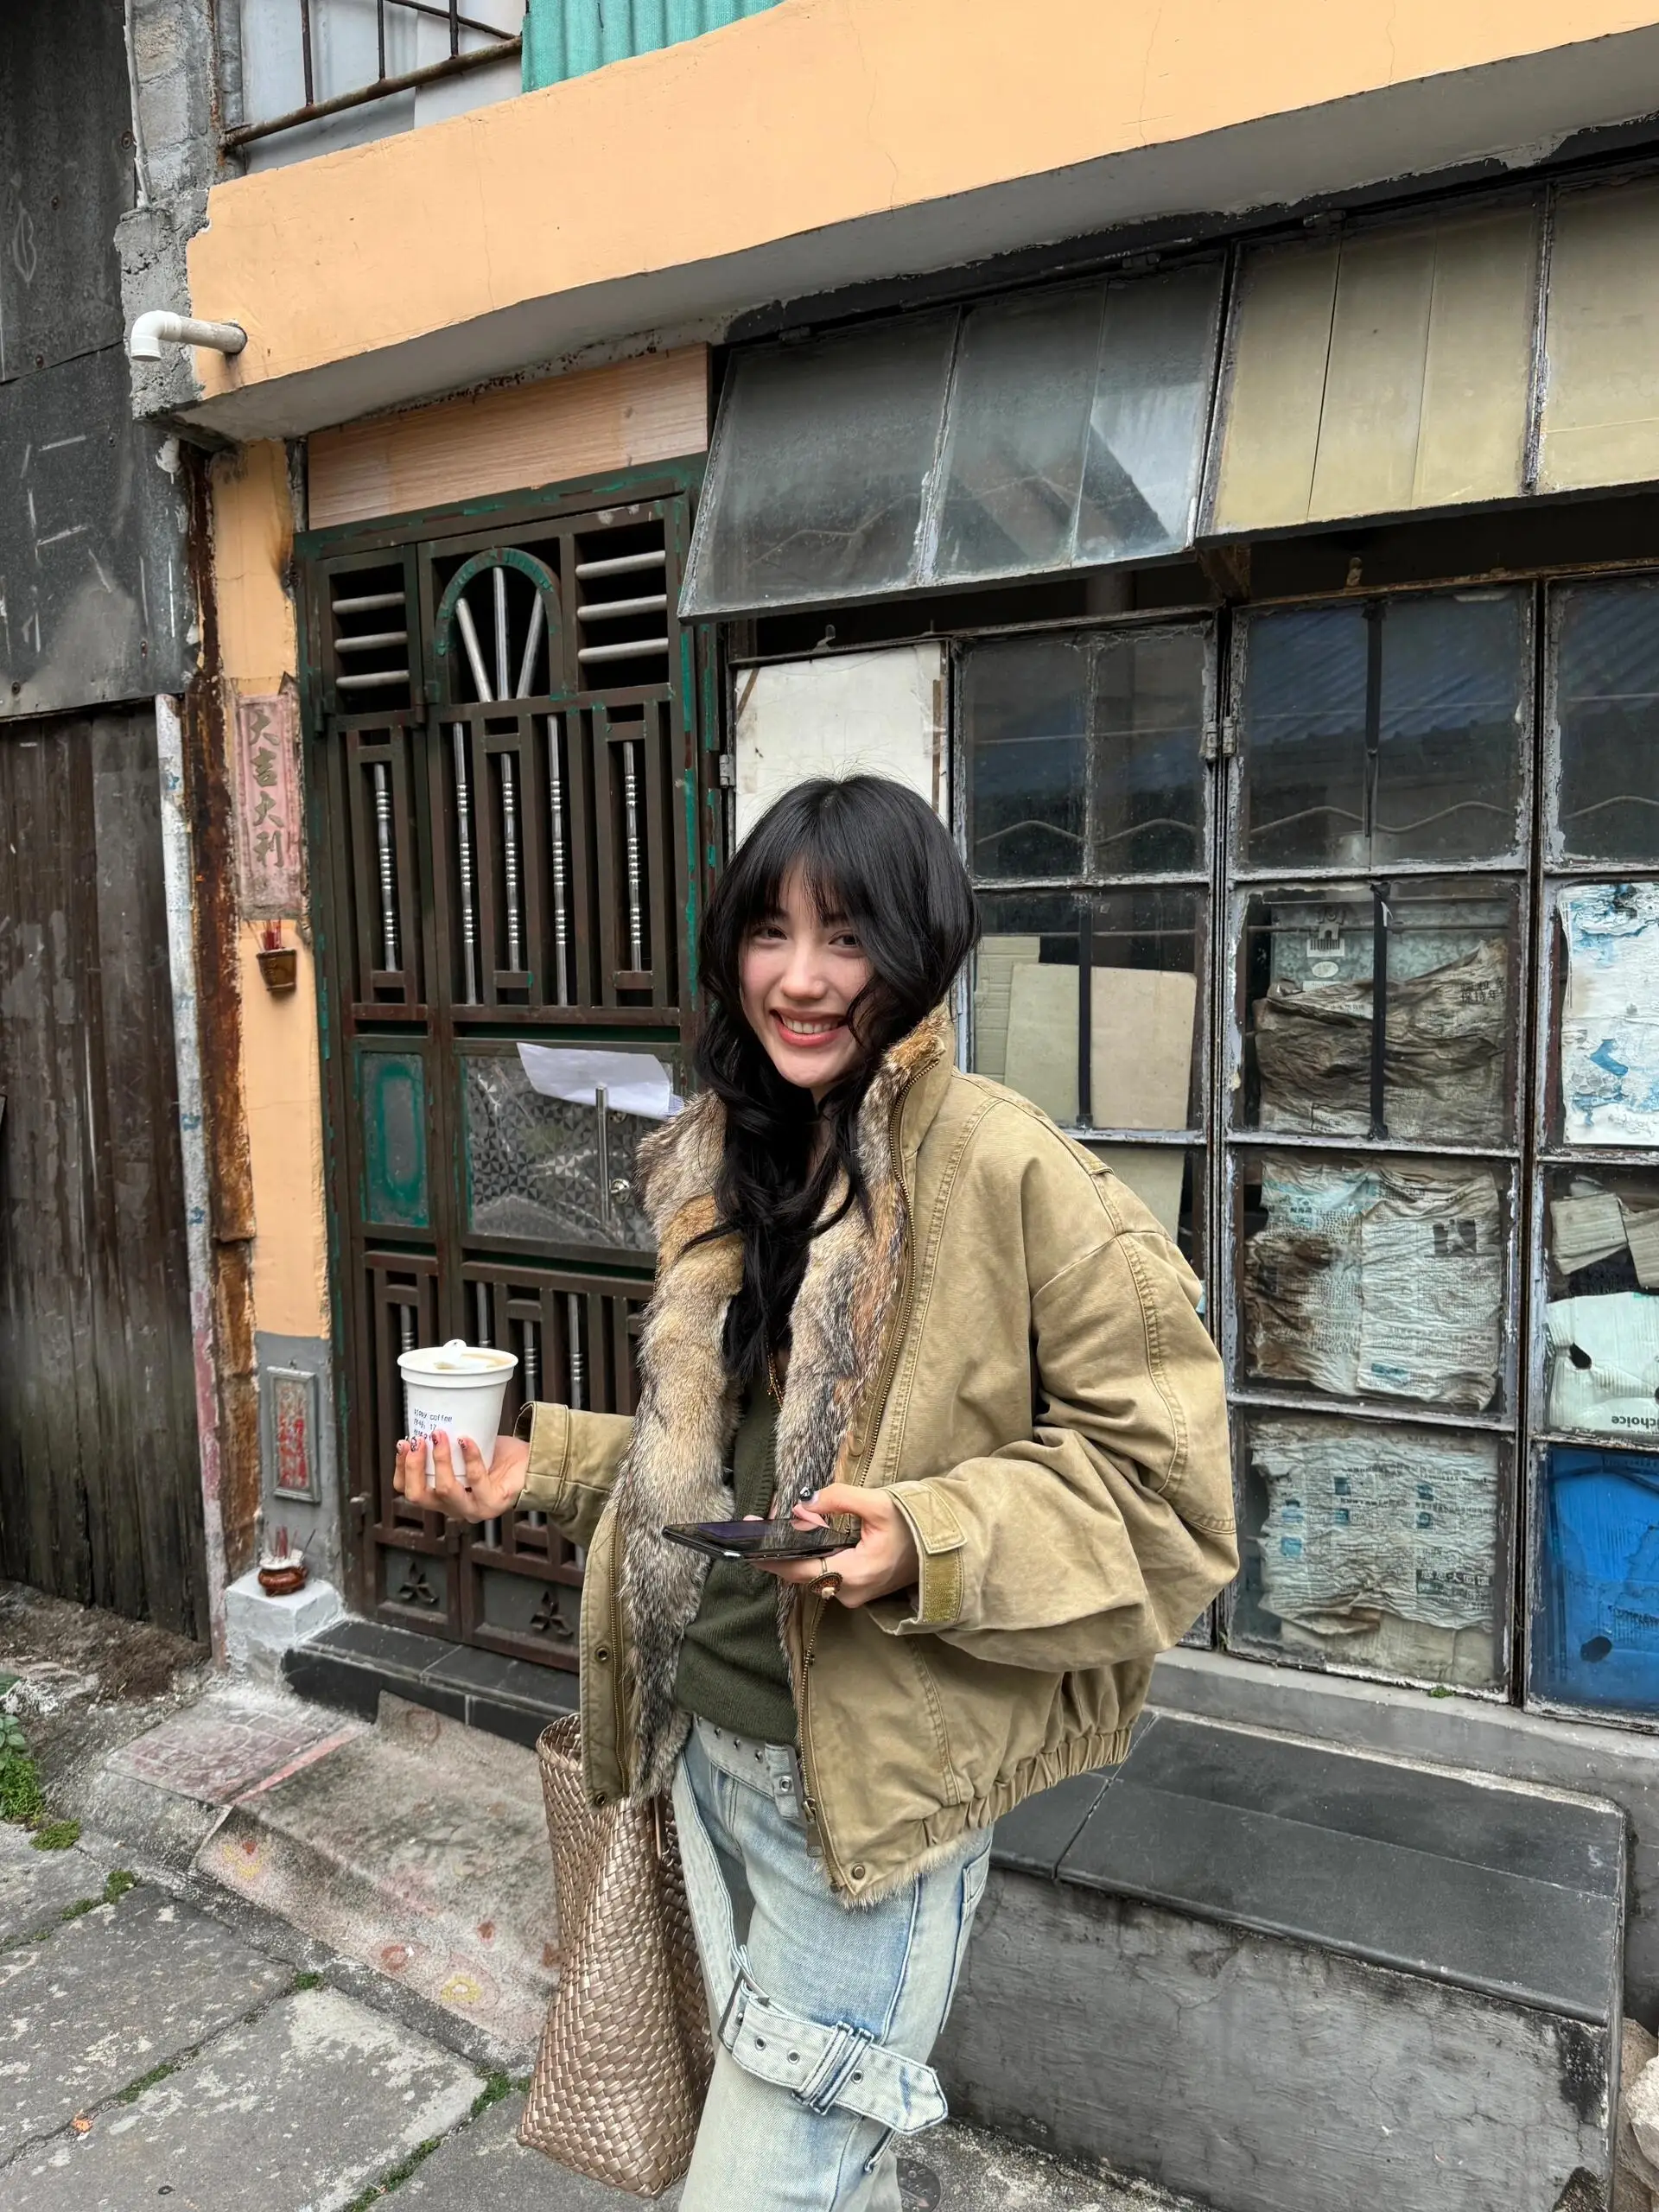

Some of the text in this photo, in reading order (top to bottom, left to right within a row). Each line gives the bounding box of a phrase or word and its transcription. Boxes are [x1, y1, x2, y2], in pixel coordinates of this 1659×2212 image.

[248, 708, 286, 868] 大吉大利
[1611, 1415, 1659, 1429] choice
